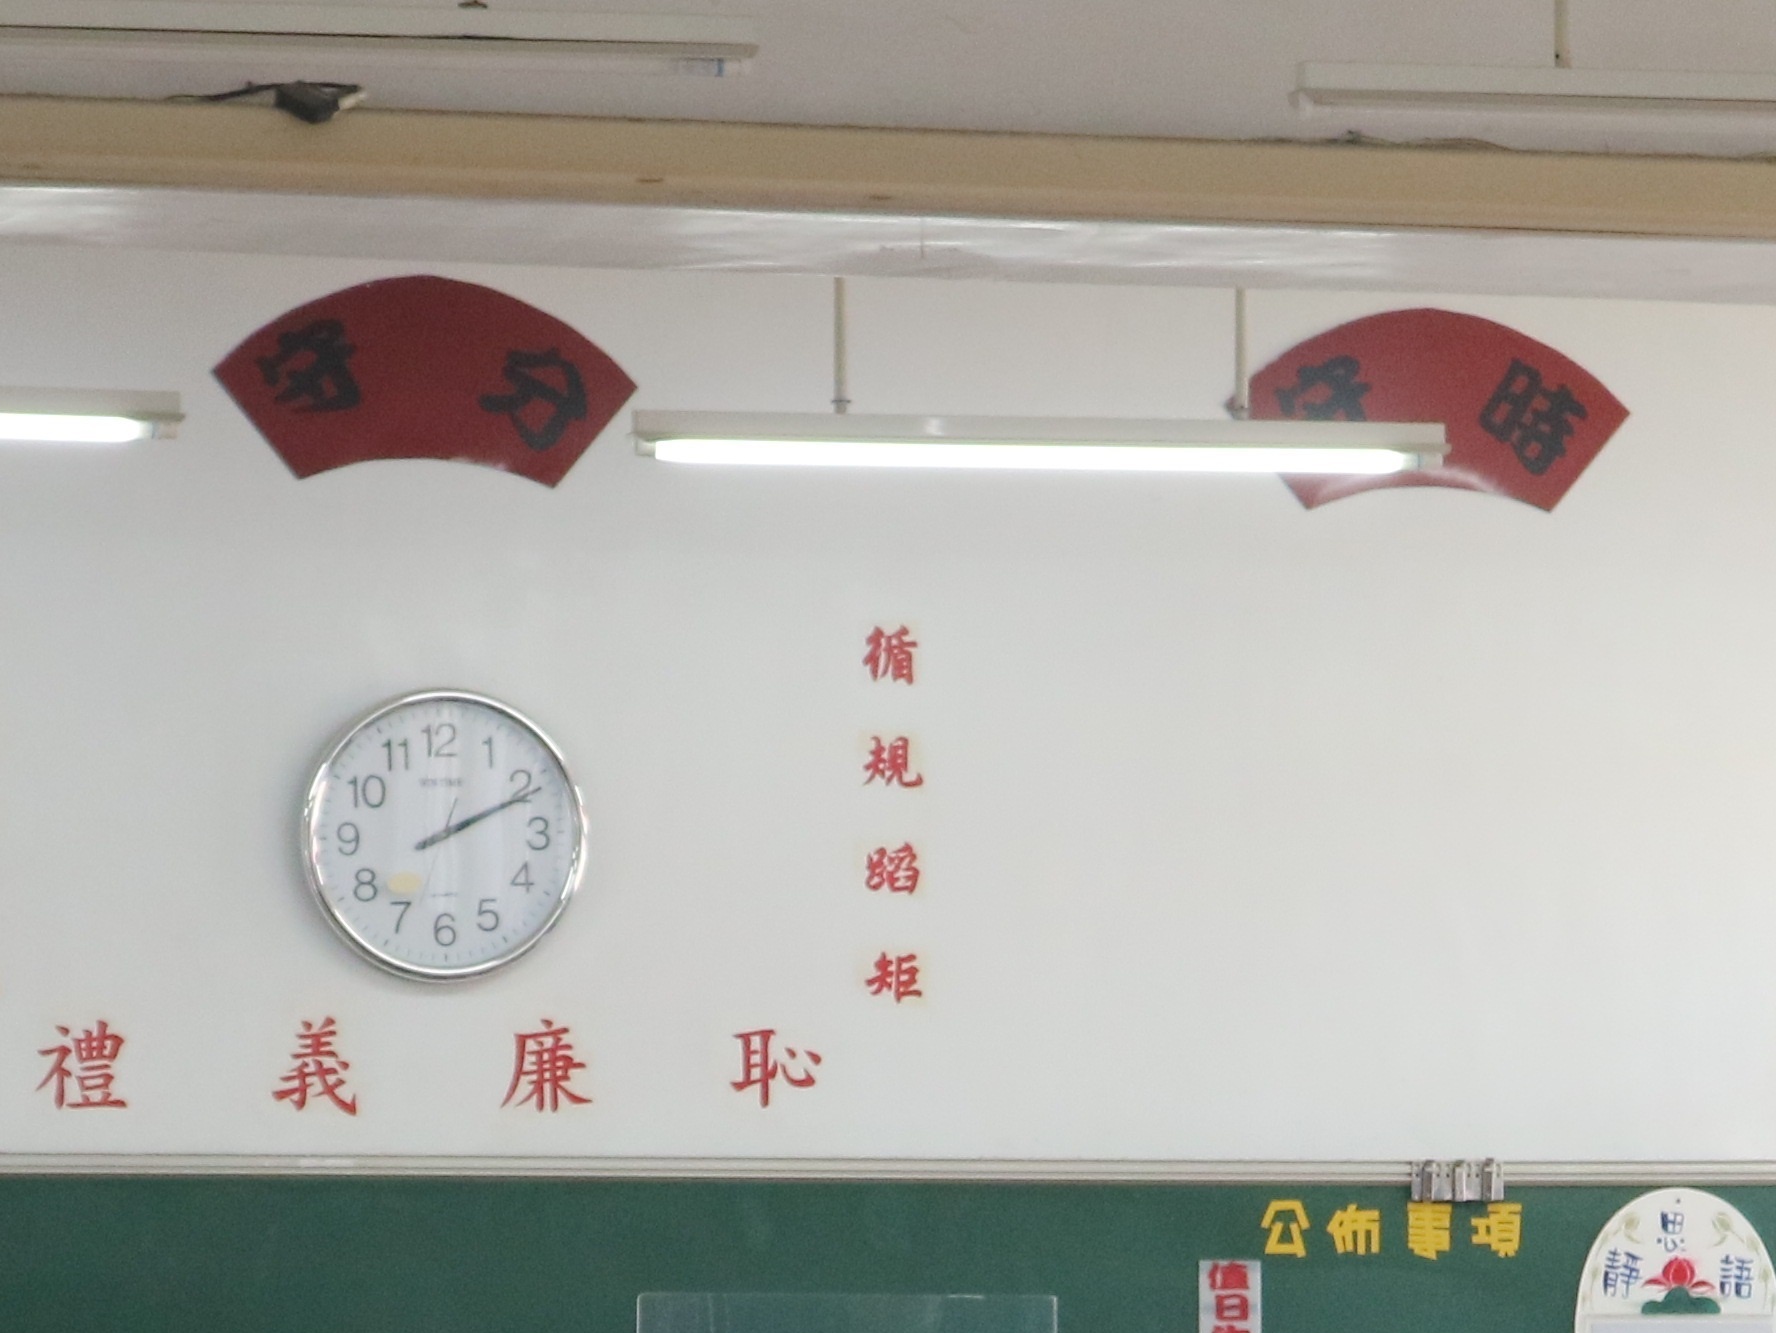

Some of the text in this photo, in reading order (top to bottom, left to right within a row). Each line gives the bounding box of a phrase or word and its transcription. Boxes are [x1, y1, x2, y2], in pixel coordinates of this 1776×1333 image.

[381, 738, 411, 772] 11
[419, 723, 459, 759] 12
[481, 736, 496, 768] 1
[347, 774, 386, 809] 10
[508, 769, 534, 803] 2
[863, 625, 923, 1002] 循規蹈矩
[336, 822, 360, 856] 9
[525, 818, 552, 852] 3
[353, 868, 378, 901] 8
[509, 861, 536, 894] 4
[389, 901, 412, 935] 7
[433, 913, 457, 946] 6
[475, 898, 501, 934] 5
[36, 1017, 822, 1115] 禮義廉恥
[1260, 1199, 1522, 1260] 公佈事項
